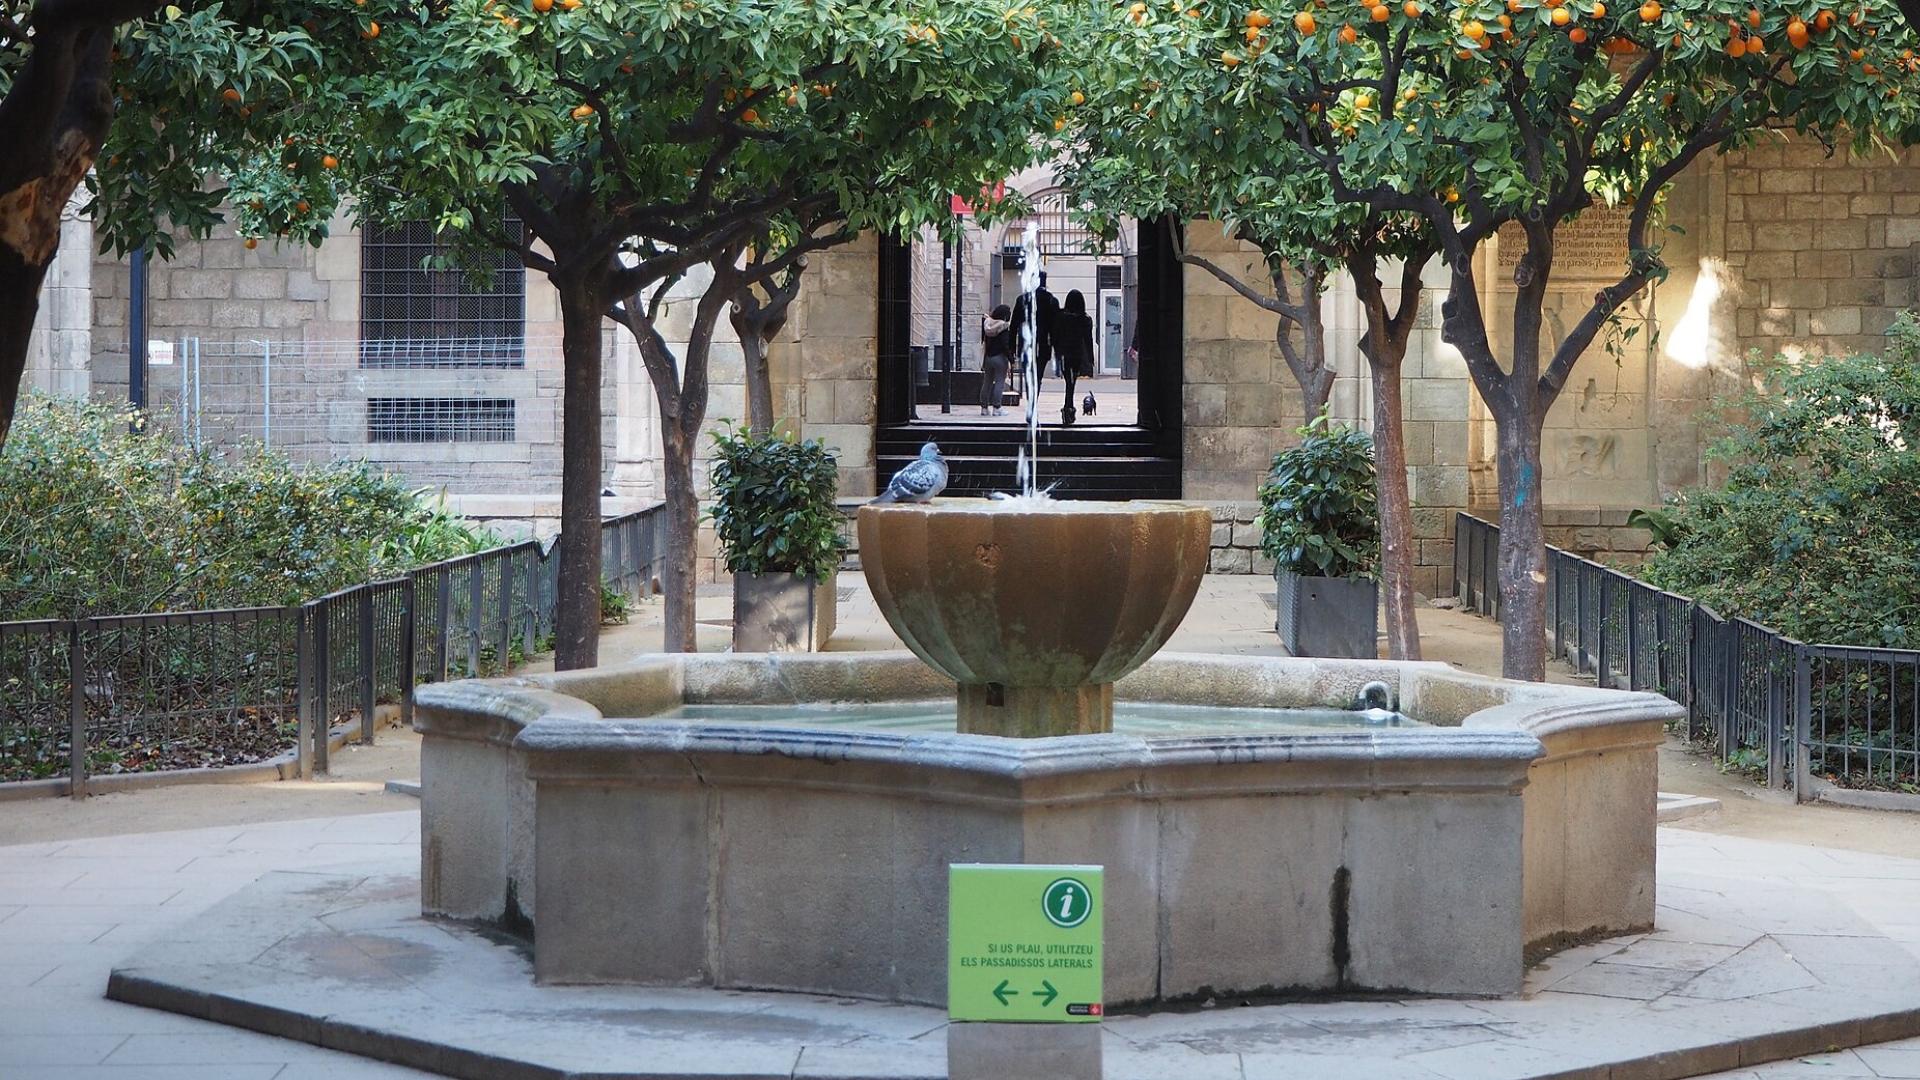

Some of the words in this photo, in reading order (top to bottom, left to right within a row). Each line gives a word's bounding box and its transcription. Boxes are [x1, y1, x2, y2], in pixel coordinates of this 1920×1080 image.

[988, 943, 998, 953] SI
[1000, 943, 1013, 953] US
[1016, 943, 1043, 955] PLAU,
[1046, 944, 1093, 955] UTILITZEU
[961, 957, 977, 967] ELS
[980, 957, 1045, 968] PASSADISSOS
[1048, 958, 1093, 969] LATERALS
